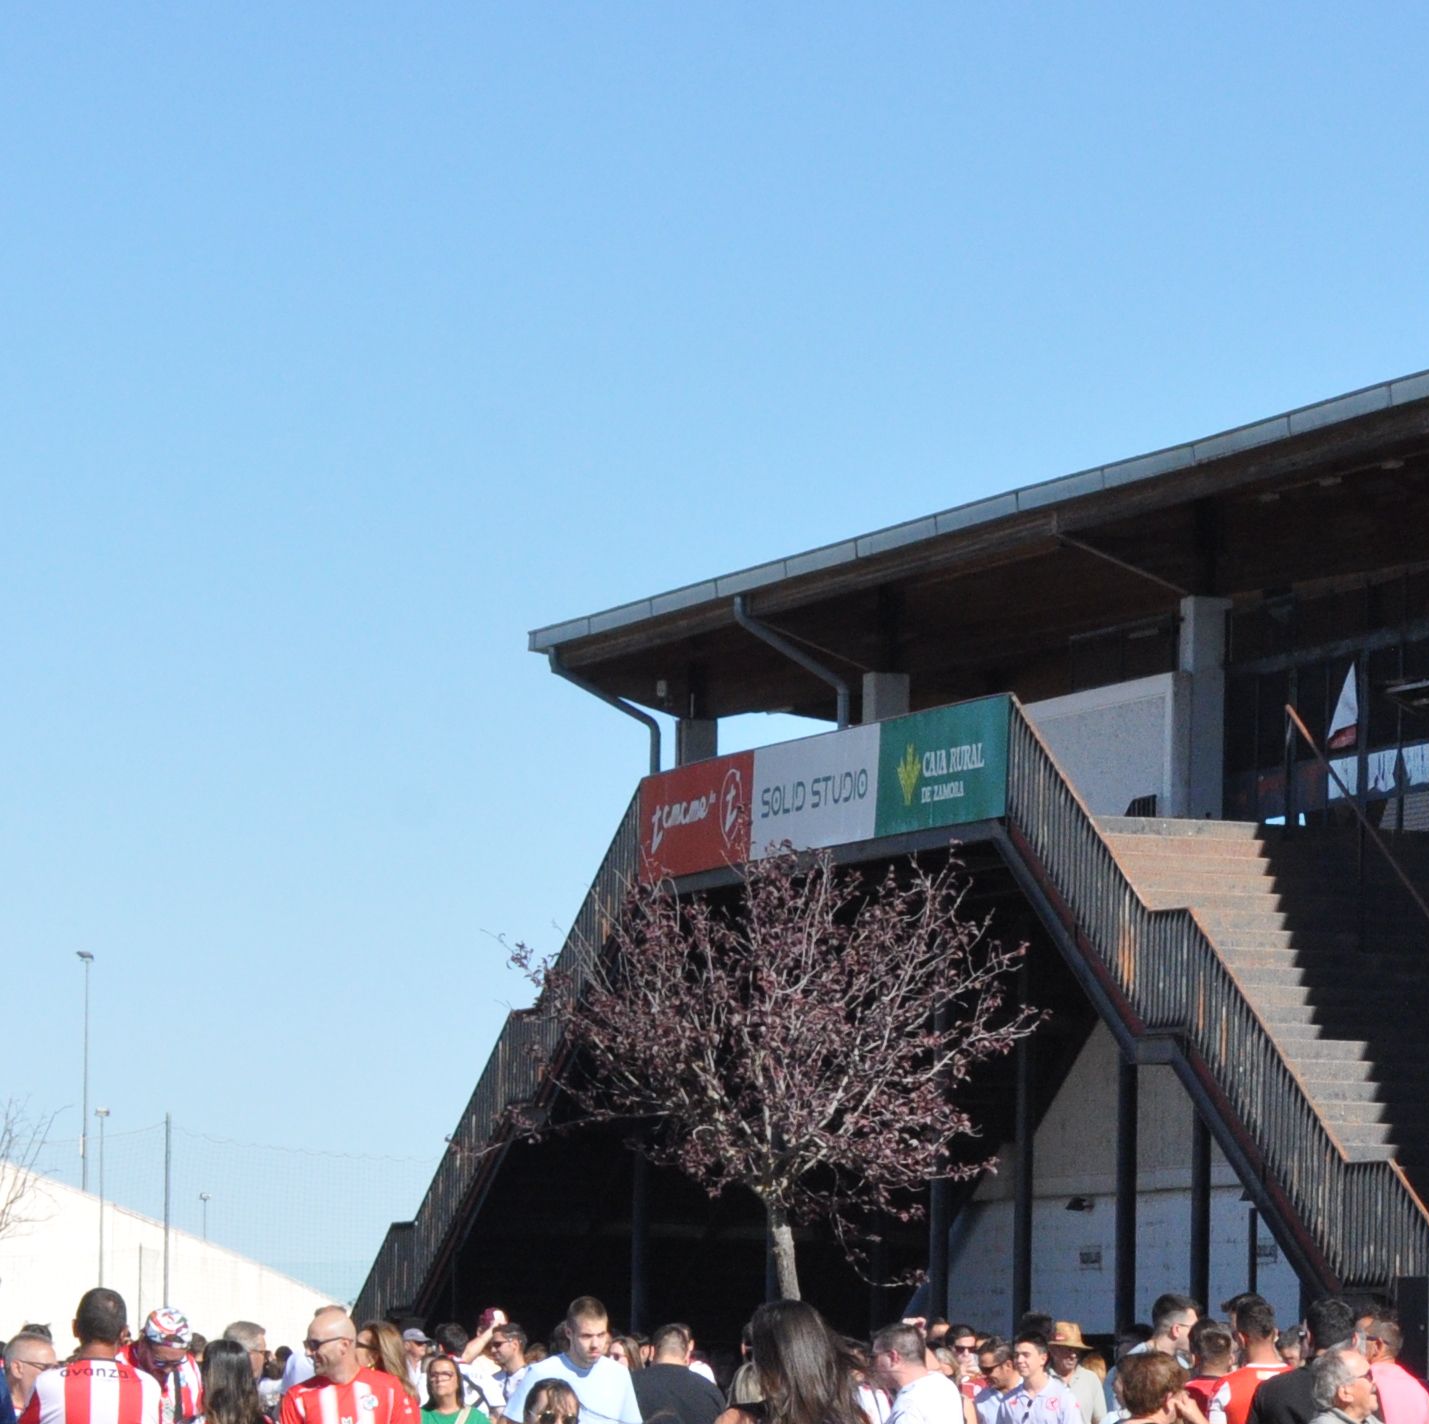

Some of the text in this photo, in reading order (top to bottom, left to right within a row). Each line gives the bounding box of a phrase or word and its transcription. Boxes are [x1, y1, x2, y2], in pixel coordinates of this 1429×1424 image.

[922, 742, 985, 778] CAJA RURAL
[761, 768, 868, 818] SOLID STUDIO
[921, 780, 964, 803] DE ZAMORA
[60, 1367, 129, 1379] avanza
